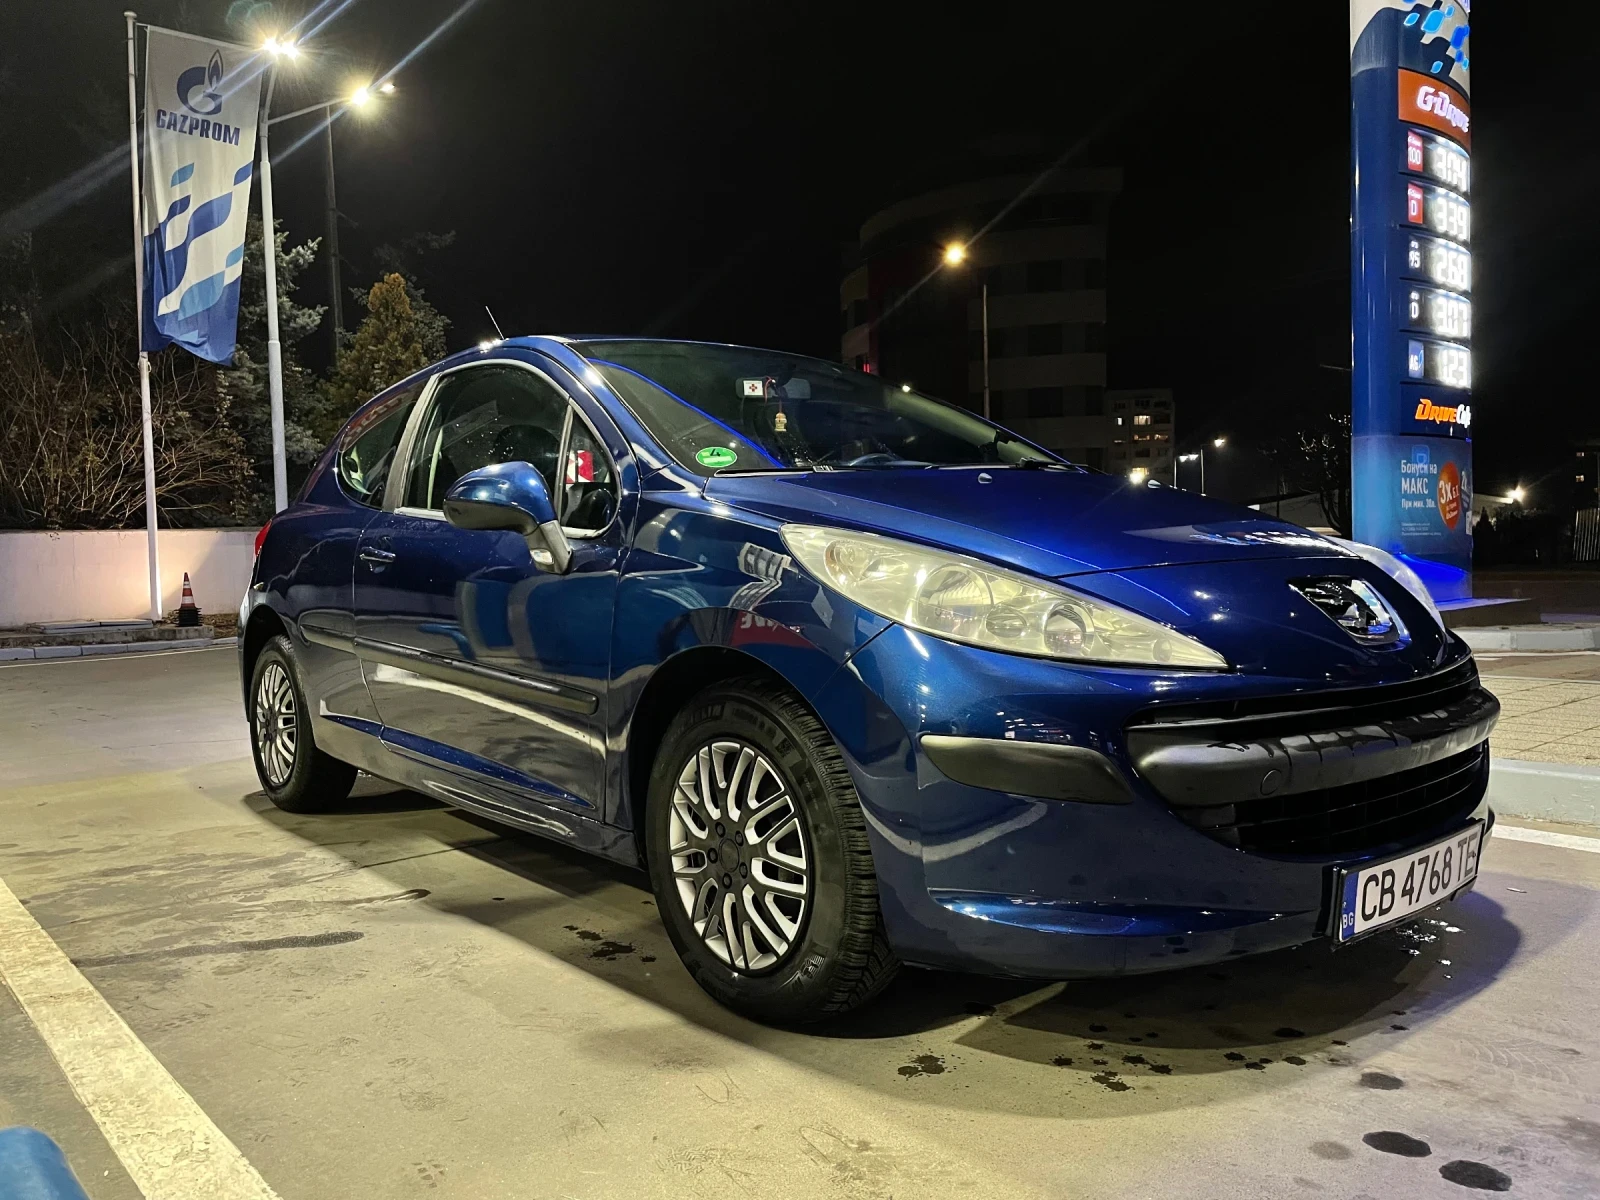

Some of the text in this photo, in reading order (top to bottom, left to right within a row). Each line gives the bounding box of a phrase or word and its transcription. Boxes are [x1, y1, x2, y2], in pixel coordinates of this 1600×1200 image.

[156, 108, 241, 147] GAZPROM
[1411, 199, 1418, 216] D
[1408, 250, 1420, 268] 95
[1410, 301, 1419, 319] D
[1429, 464, 1438, 474] на
[1401, 477, 1428, 494] МАКС
[1361, 832, 1478, 922] CB 4768 TE
[1342, 911, 1355, 929] BG
